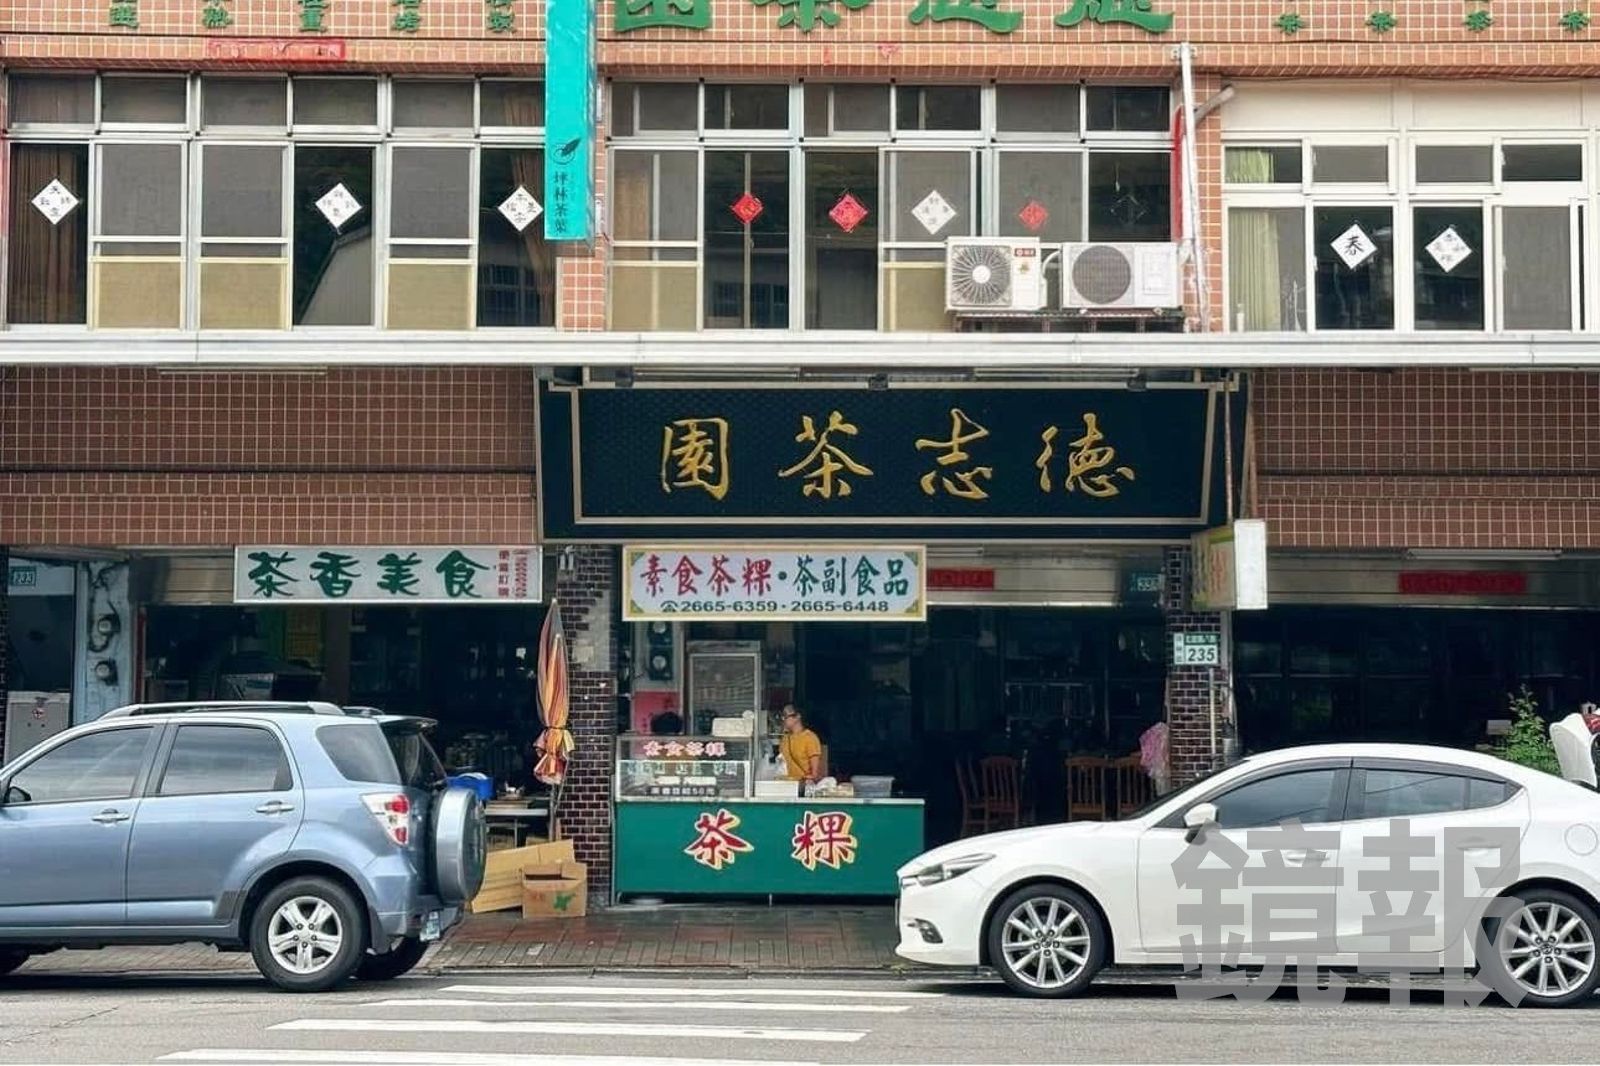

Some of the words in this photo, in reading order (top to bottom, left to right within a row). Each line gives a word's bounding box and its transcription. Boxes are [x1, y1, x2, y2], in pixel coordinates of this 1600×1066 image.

[248, 550, 491, 598] 茶香美食
[1188, 648, 1215, 662] 235
[685, 808, 857, 870] 茶粿
